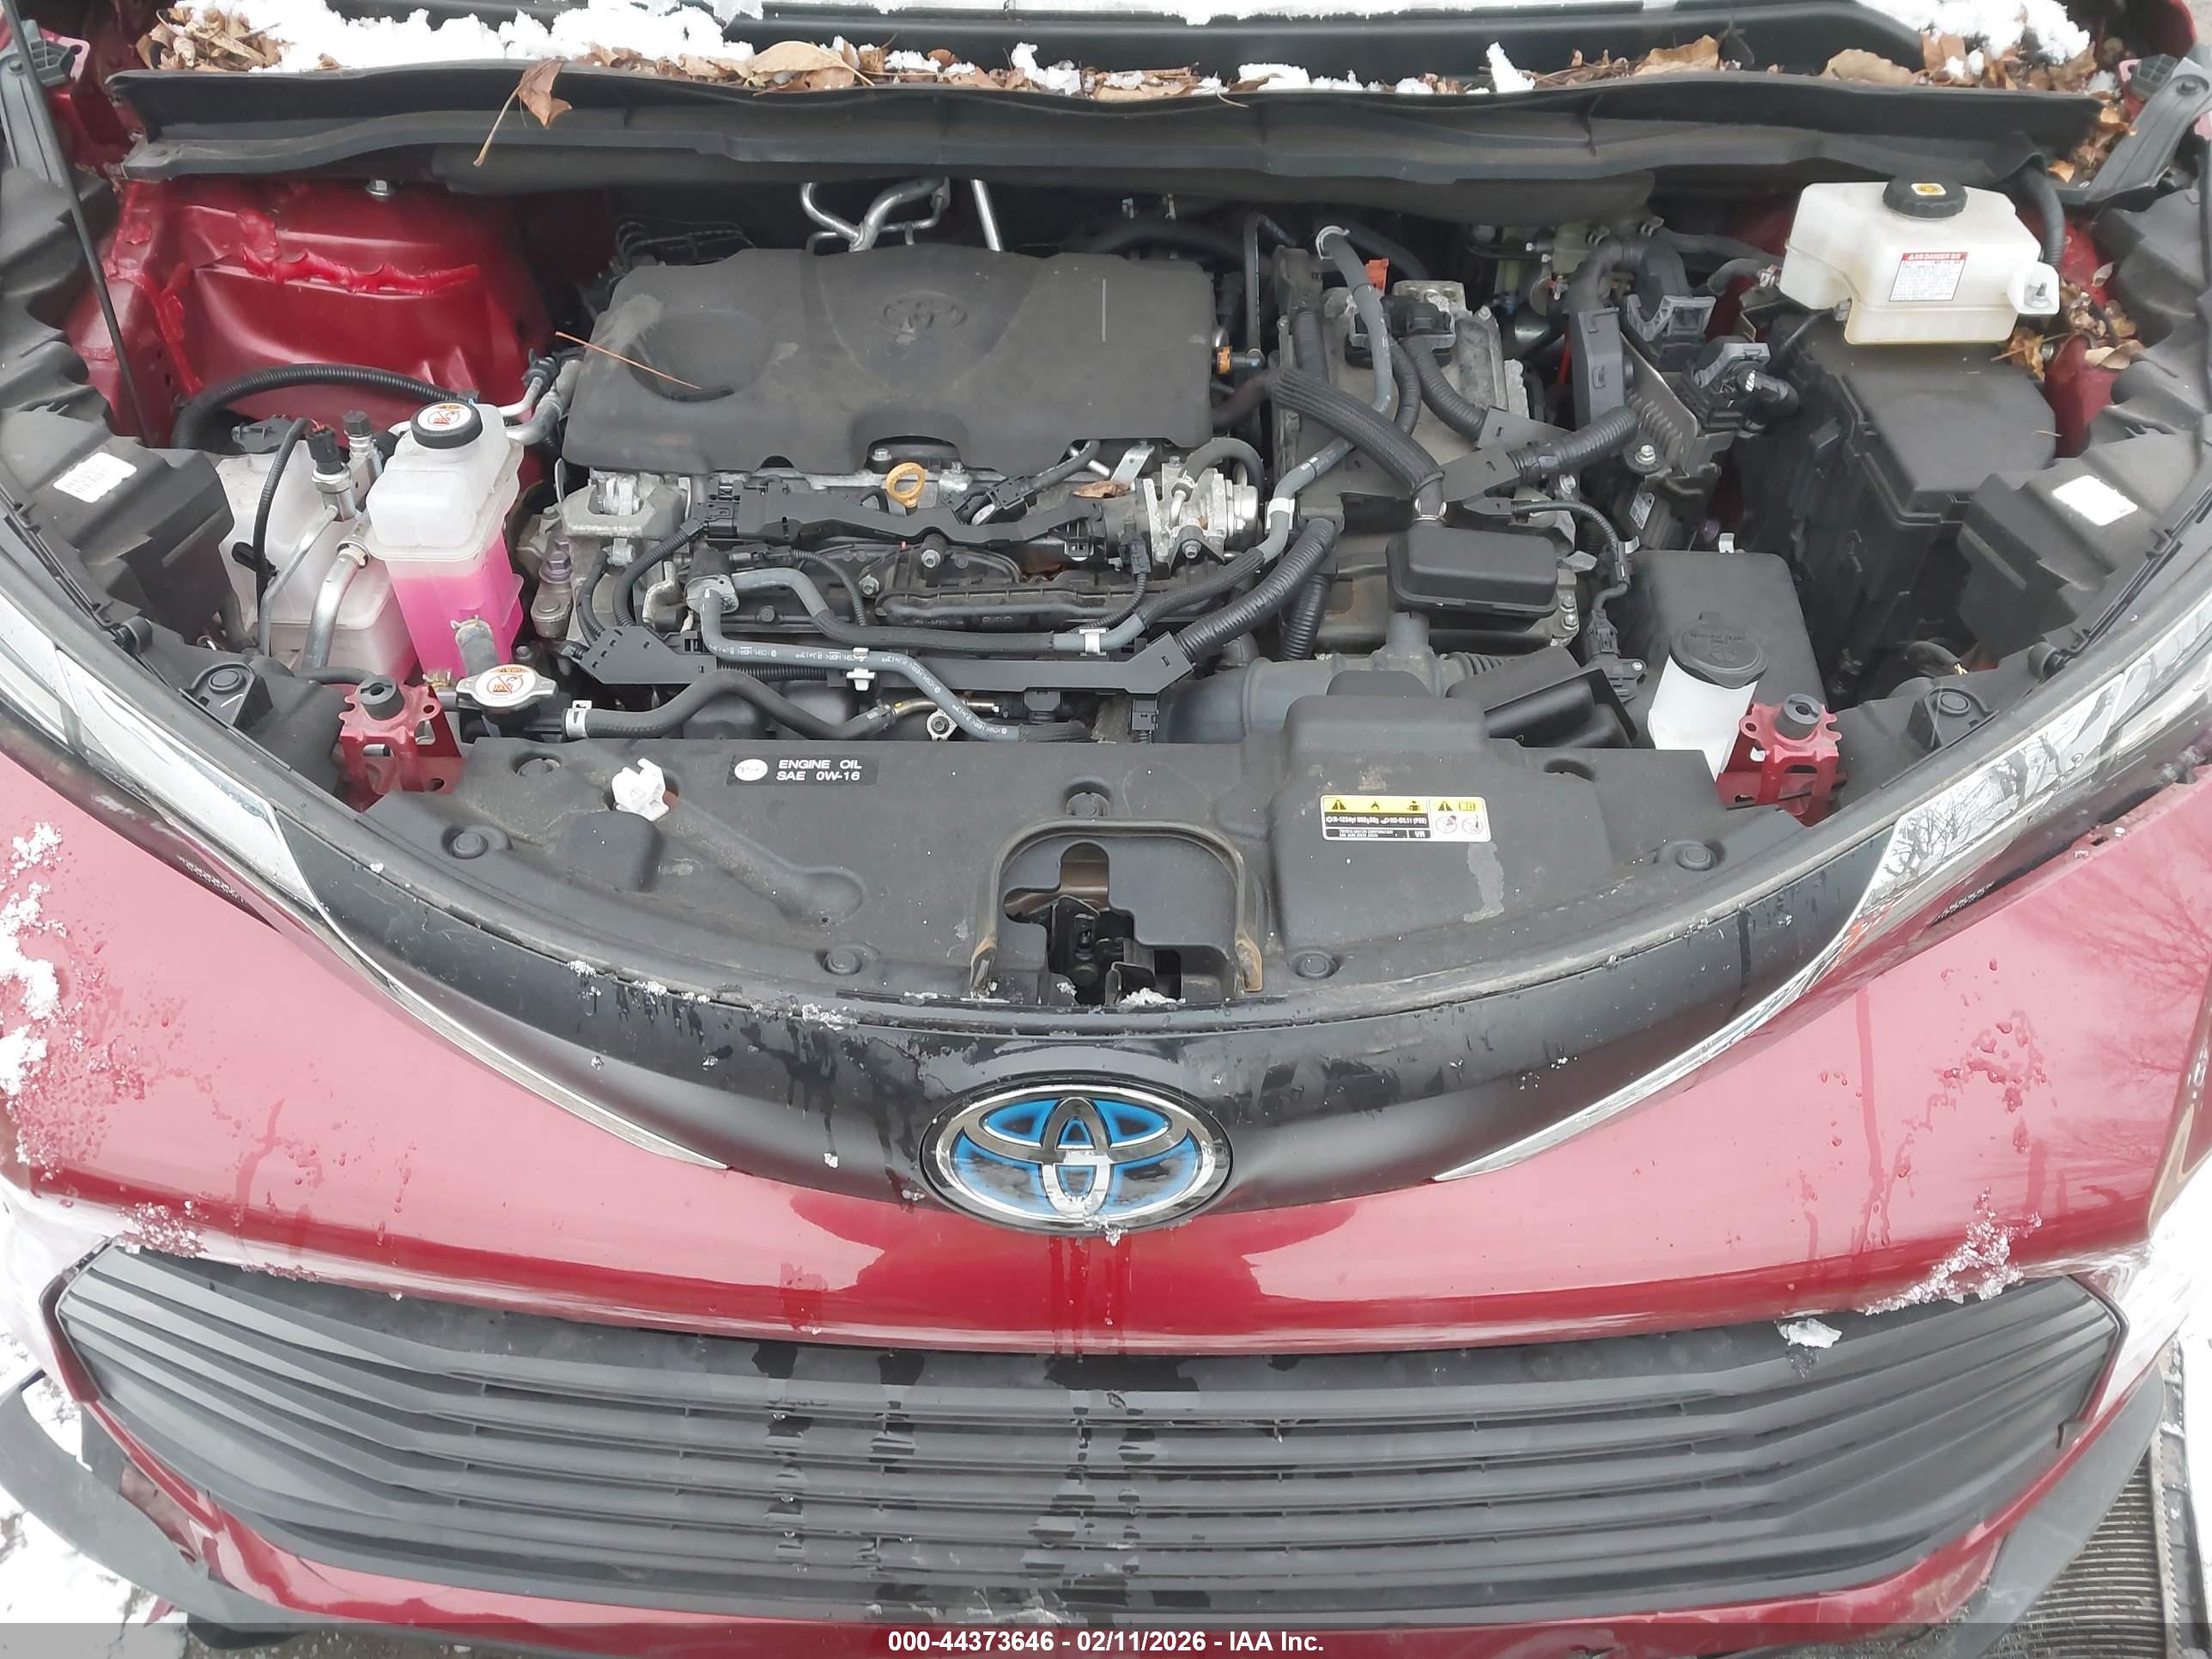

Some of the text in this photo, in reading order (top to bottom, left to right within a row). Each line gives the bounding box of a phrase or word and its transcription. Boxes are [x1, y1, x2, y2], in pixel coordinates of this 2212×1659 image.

[778, 759, 863, 769] ENGINE OIL
[776, 771, 860, 781] SAE 0W-16
